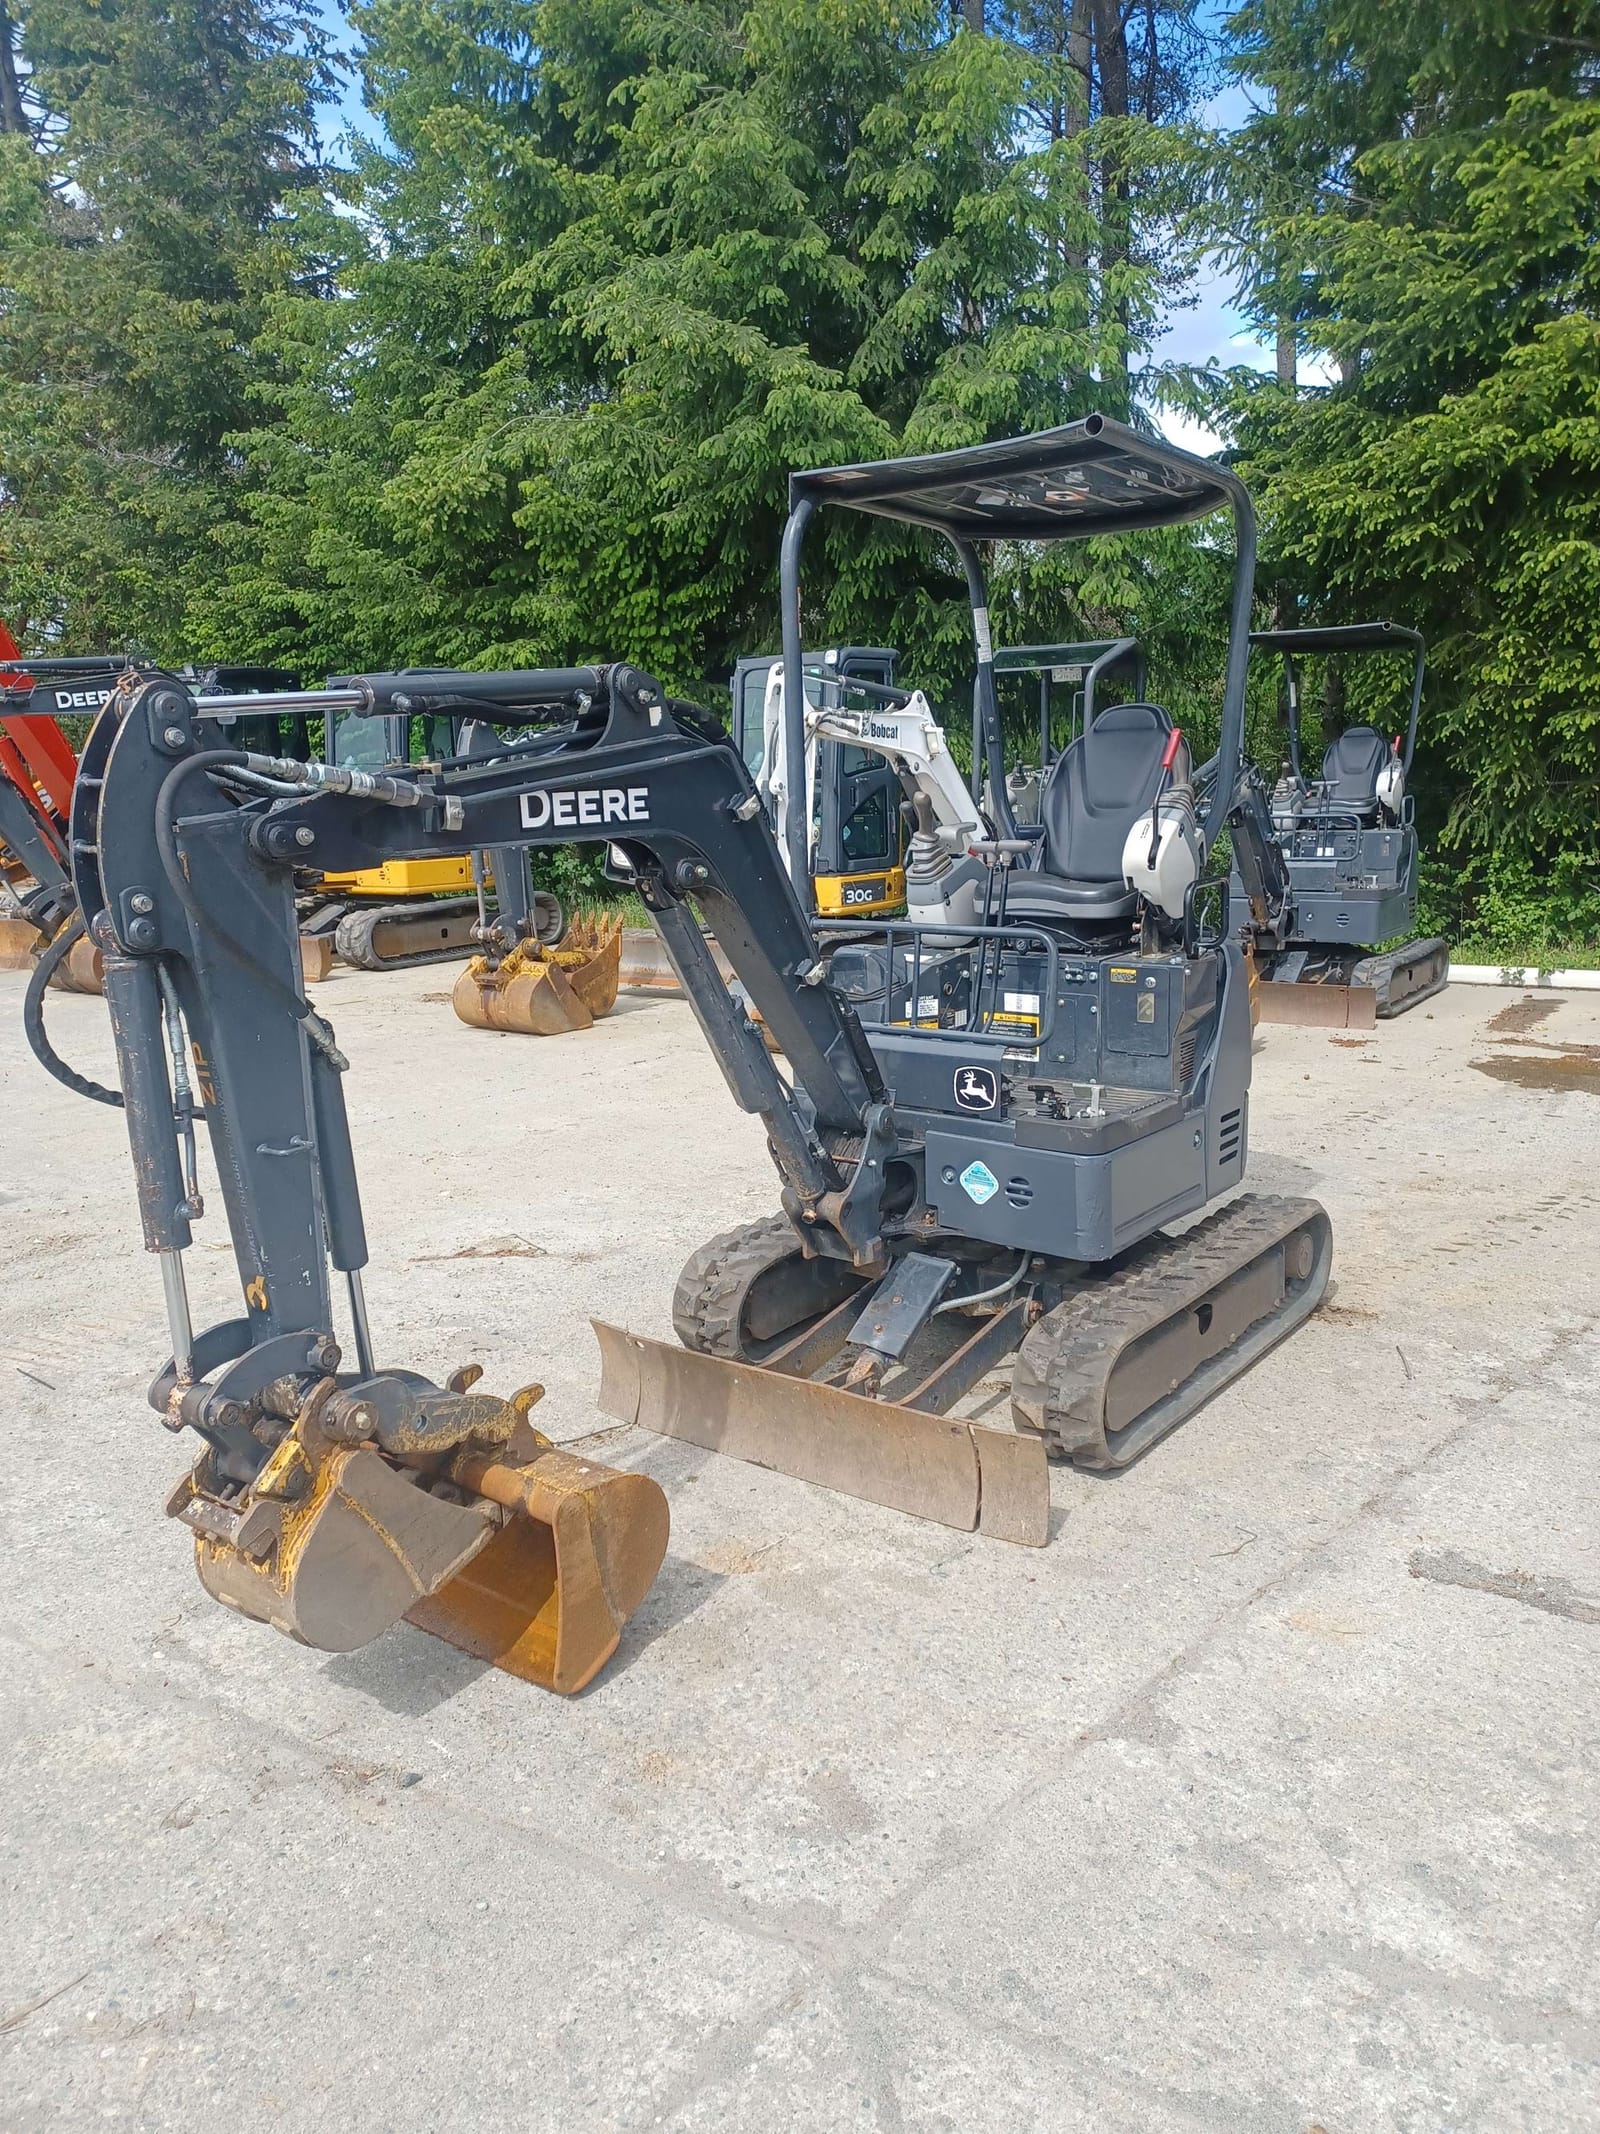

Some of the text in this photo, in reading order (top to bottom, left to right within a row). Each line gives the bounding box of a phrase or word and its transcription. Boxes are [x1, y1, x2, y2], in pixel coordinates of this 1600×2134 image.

[54, 690, 117, 709] DEER
[870, 722, 899, 738] Bobcat
[519, 786, 650, 829] DEERE
[845, 889, 873, 904] 30G
[192, 1041, 216, 1106] ZIP
